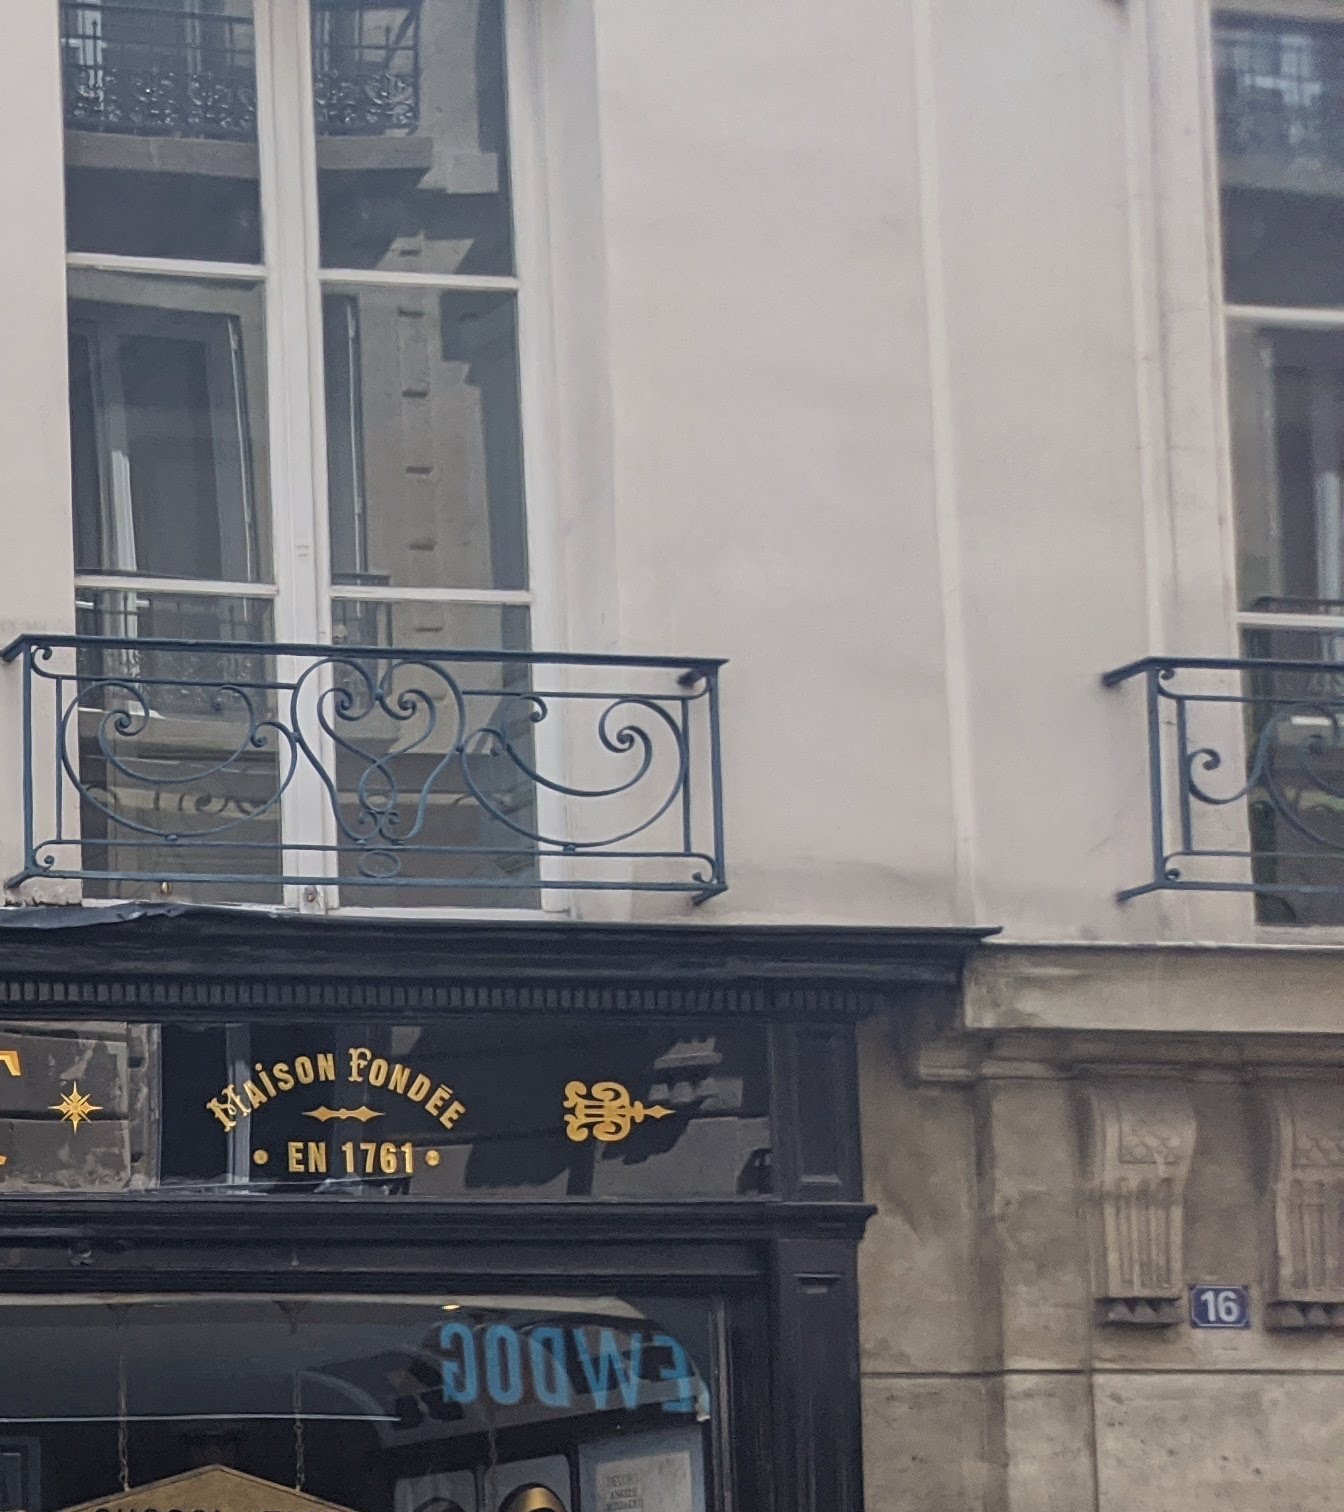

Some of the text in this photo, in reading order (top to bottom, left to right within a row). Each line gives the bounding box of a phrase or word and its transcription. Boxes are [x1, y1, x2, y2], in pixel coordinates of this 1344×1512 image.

[287, 1141, 413, 1175] EN 1761
[1200, 1290, 1240, 1322] 16
